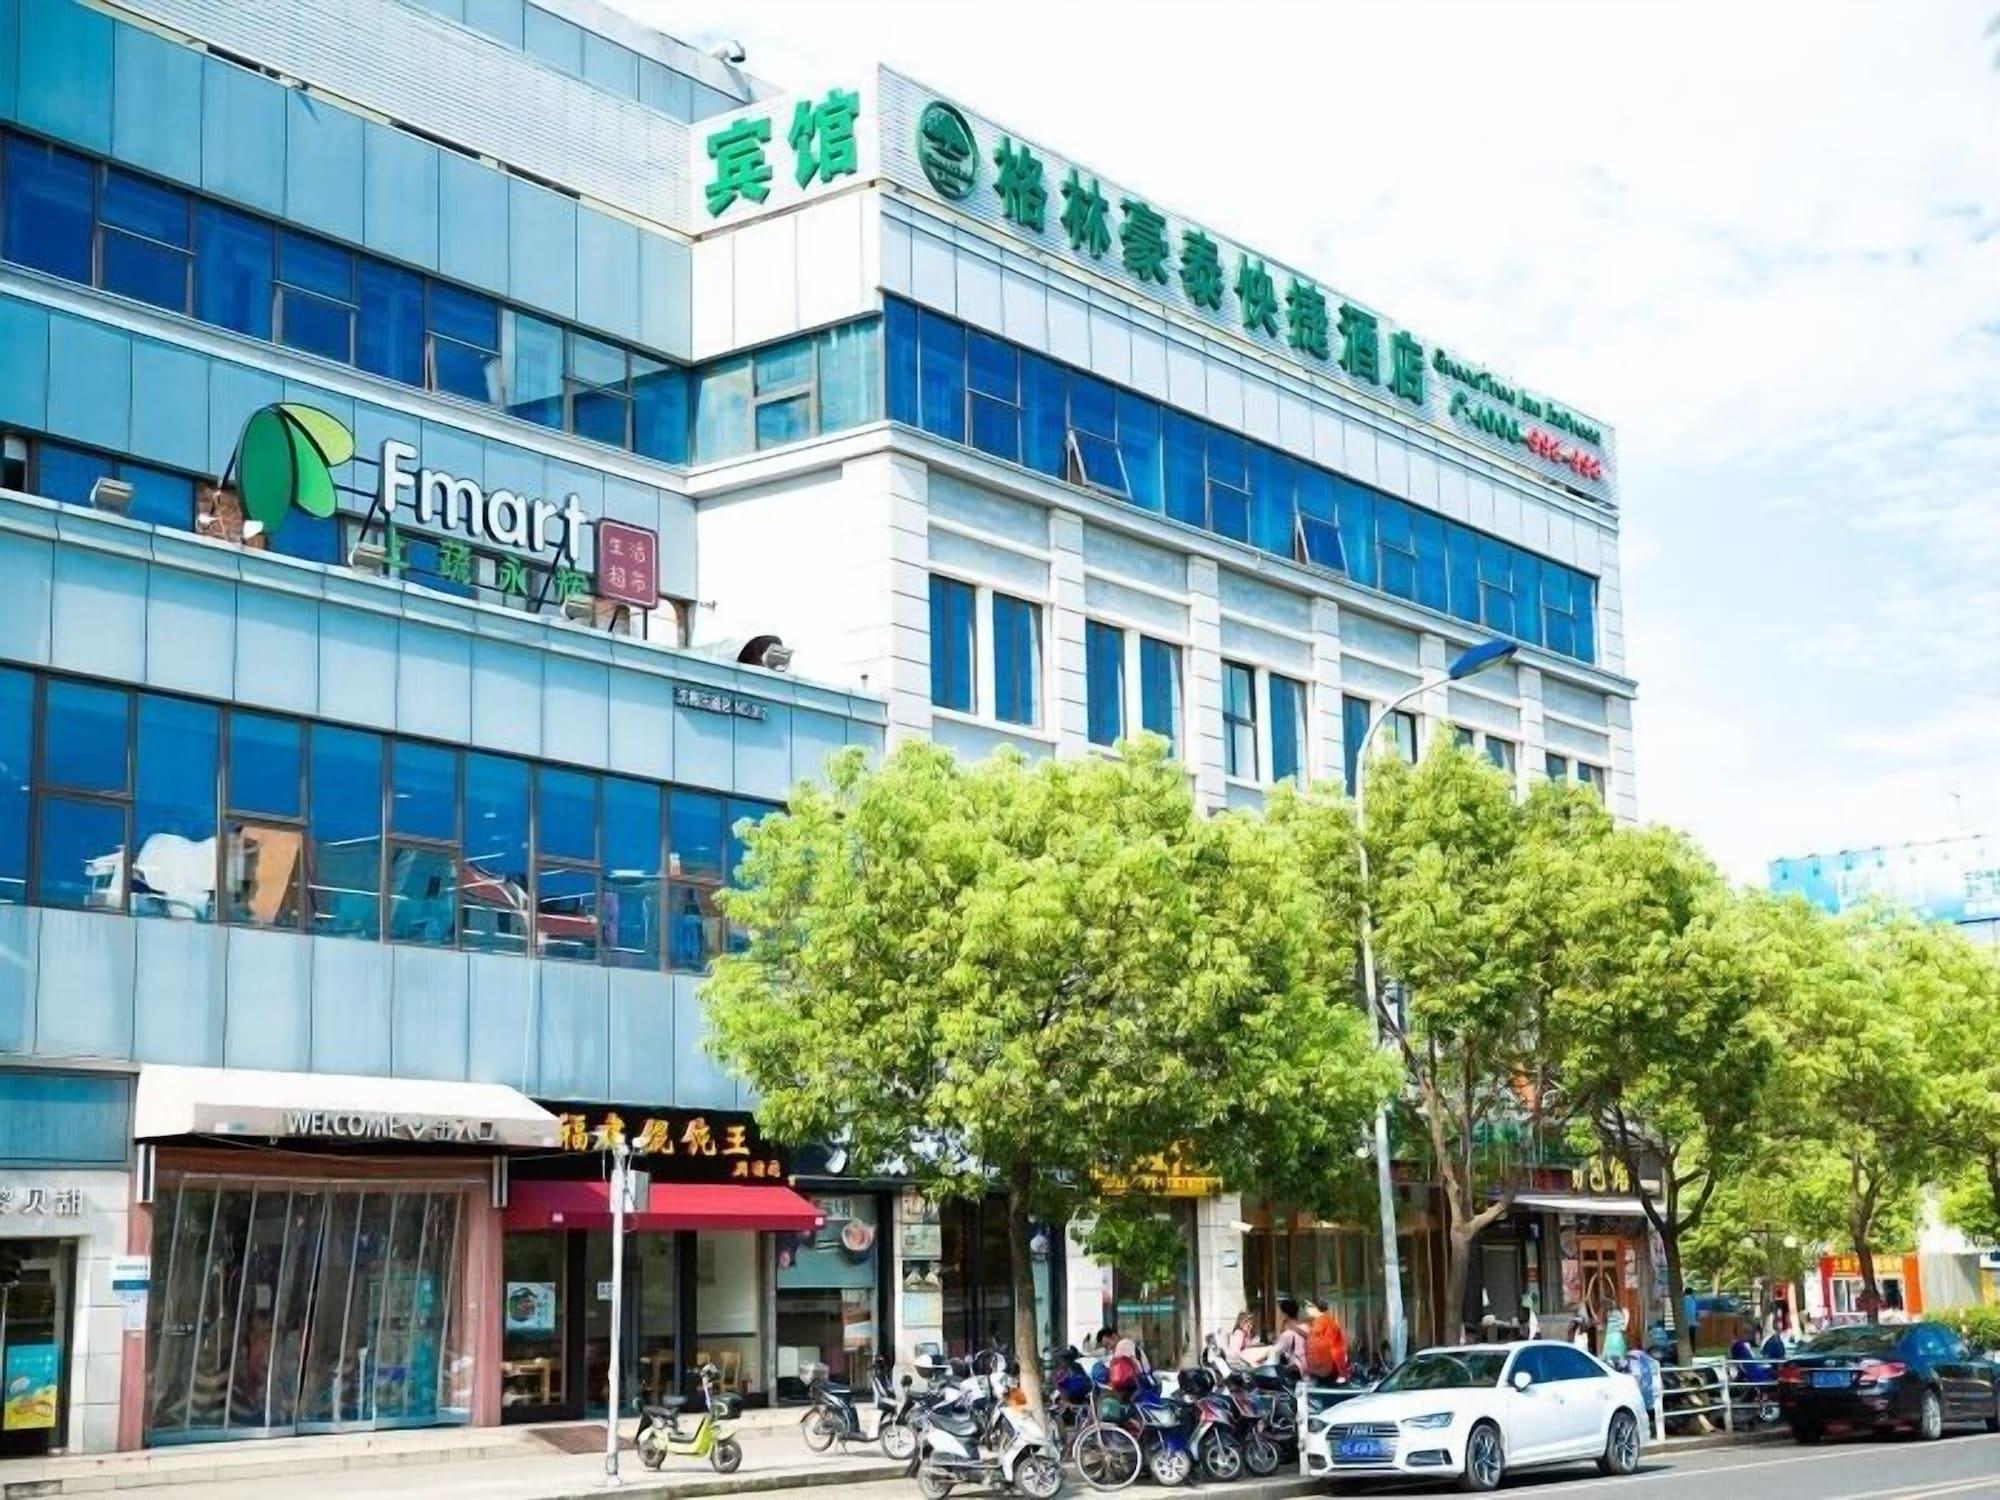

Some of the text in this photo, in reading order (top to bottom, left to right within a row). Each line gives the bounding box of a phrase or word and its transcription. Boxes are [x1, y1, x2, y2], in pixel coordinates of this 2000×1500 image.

[705, 87, 861, 217] 宾馆
[992, 135, 1426, 407] 格林豪泰快捷酒店
[382, 439, 589, 560] Fmart
[608, 536, 646, 563] 生活
[608, 566, 646, 593] 超市
[284, 1111, 400, 1139] WELCOME
